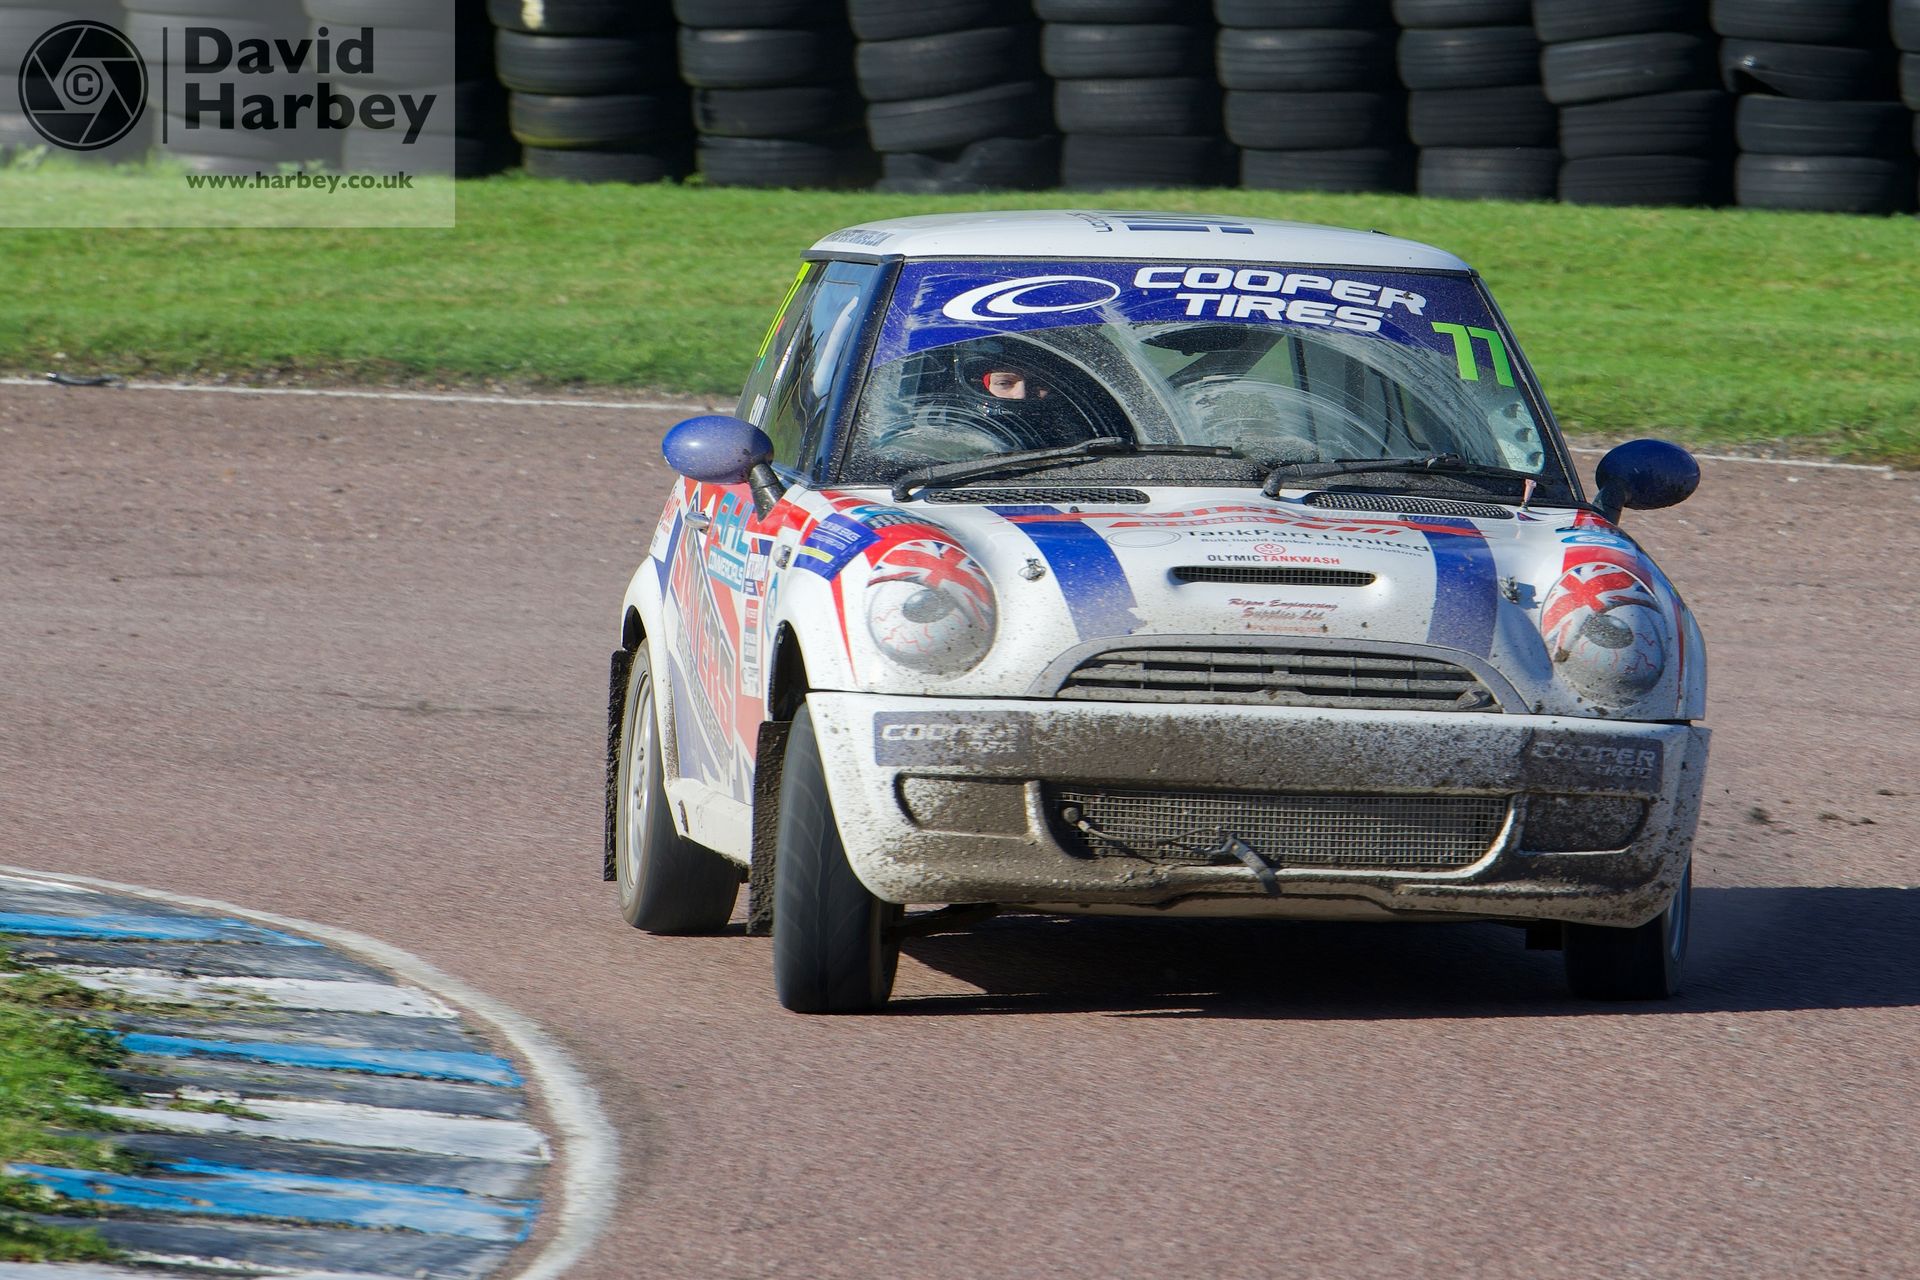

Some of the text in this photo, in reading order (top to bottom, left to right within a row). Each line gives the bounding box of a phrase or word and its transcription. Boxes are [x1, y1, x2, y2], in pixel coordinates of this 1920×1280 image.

[1134, 266, 1427, 316] COOPER
[1176, 293, 1384, 332] TIRES
[1431, 321, 1516, 388] 77
[1182, 529, 1430, 552] TankPart Limited
